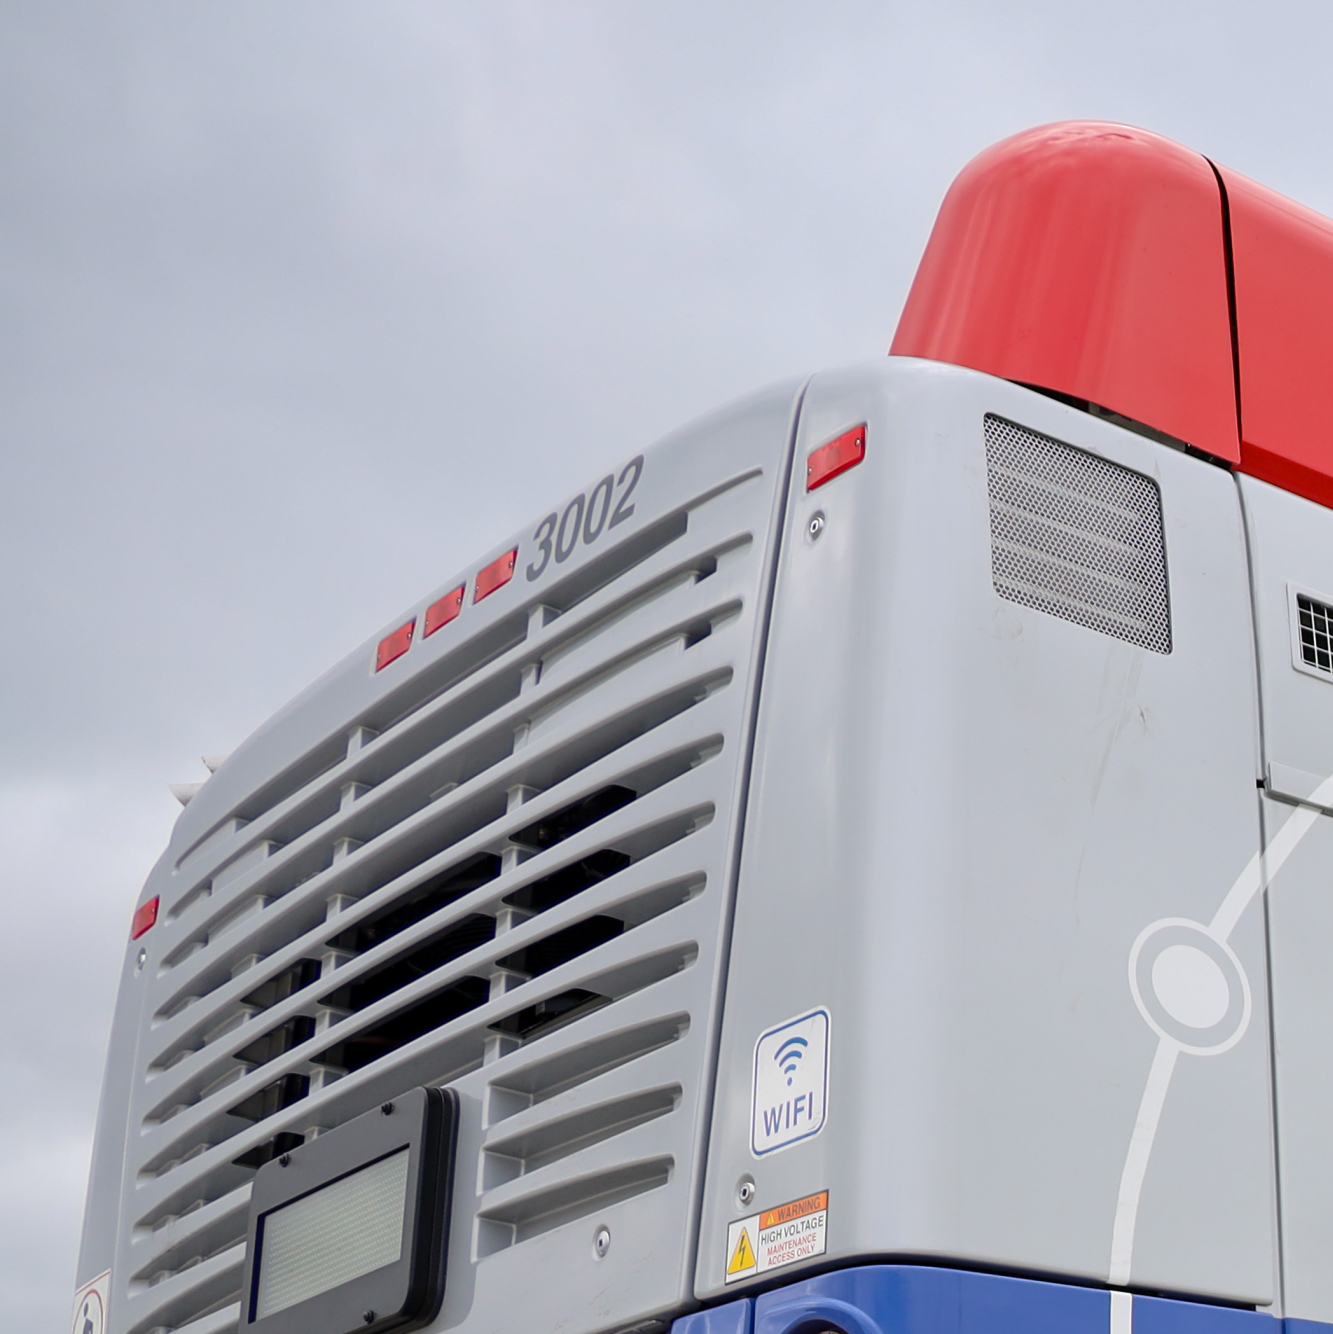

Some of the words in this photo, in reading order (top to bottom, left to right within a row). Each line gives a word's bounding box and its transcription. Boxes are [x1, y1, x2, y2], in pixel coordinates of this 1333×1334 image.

[526, 454, 644, 583] 3002
[763, 1092, 813, 1137] WIFI
[777, 1196, 821, 1221] WARNING
[761, 1229, 782, 1246] HIGH
[784, 1215, 824, 1237] VOLTAGE
[767, 1232, 817, 1255] MAINTENANCE
[768, 1251, 795, 1266] ACCESS
[797, 1244, 815, 1257] ONLY
